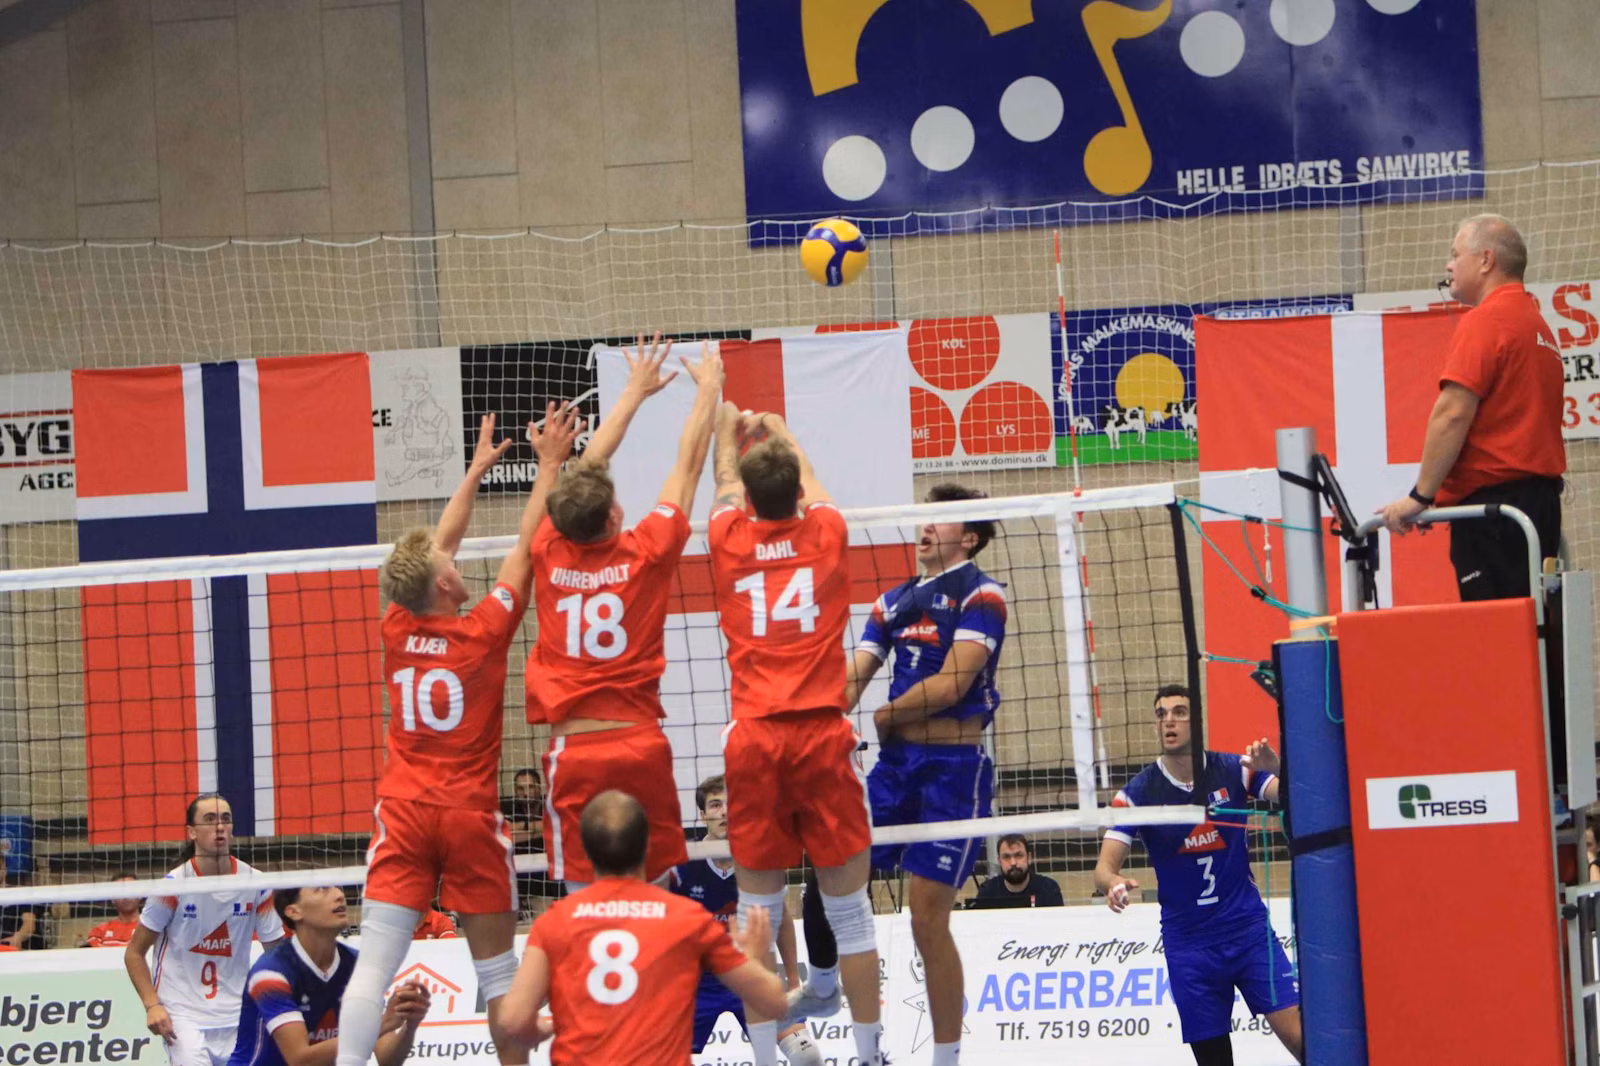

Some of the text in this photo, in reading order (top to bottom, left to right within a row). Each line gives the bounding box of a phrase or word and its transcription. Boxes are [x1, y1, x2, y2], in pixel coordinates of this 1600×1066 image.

[1177, 150, 1470, 195] HELLE IDRÆTS SAMVIRKE
[0, 420, 71, 455] YG
[996, 424, 1016, 435] LYS
[961, 454, 1048, 467] www.dominus.dk
[754, 539, 798, 561] DAHL
[734, 567, 820, 637] 14
[556, 591, 629, 659] 18
[405, 634, 448, 655] KJÆR
[392, 666, 464, 732] 10
[1418, 799, 1488, 818] TRESS
[1184, 829, 1219, 849] MAIF
[1196, 855, 1217, 897] 3
[572, 900, 666, 918] JACOBSEN
[199, 938, 231, 951] MAIF
[997, 939, 1070, 967] Energi
[1075, 938, 1149, 965] rigtige
[201, 960, 218, 999] 9
[586, 929, 639, 1005] 8
[976, 967, 1176, 1013] AGERBÆK
[0, 994, 112, 1032] bjerg
[996, 1020, 1030, 1041] Tlf.
[1038, 1020, 1090, 1040] 7519
[1097, 1017, 1150, 1038] 6200
[0, 1033, 151, 1066] center
